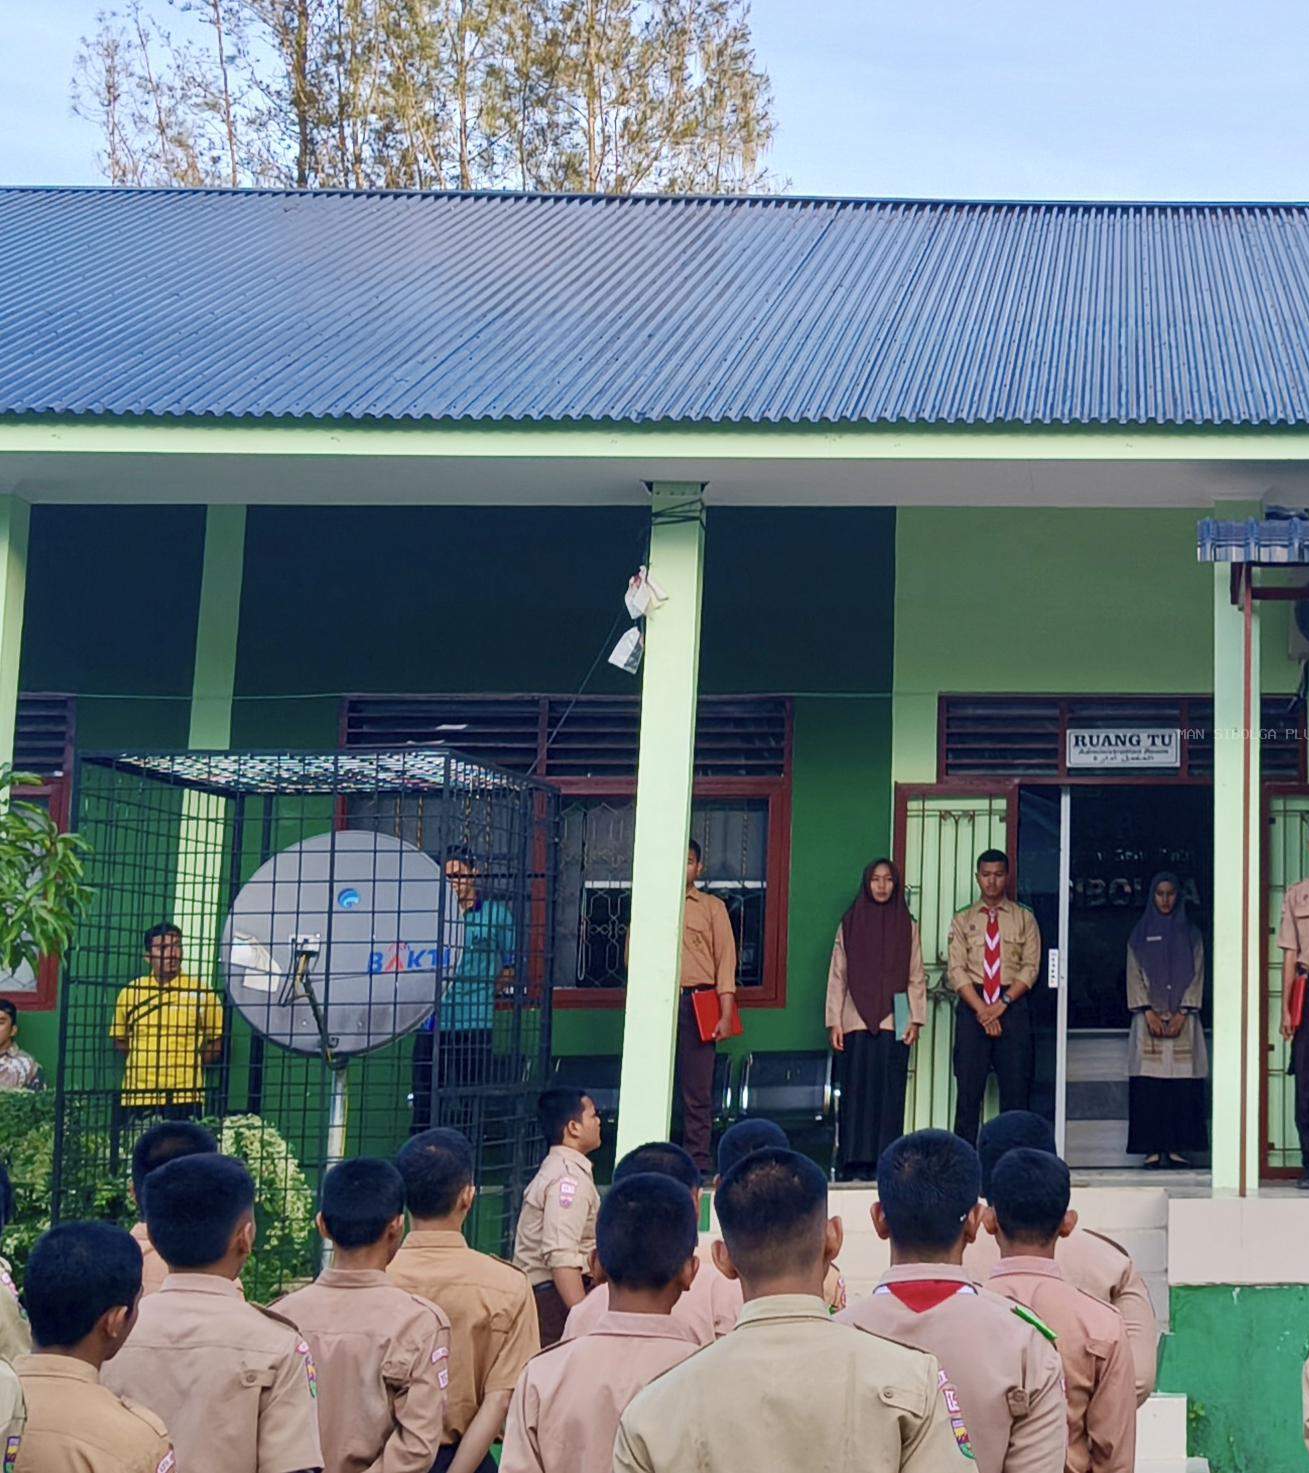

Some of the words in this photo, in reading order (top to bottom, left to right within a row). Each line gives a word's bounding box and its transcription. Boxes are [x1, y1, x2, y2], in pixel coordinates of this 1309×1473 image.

[1073, 734, 1141, 747] RUANG
[1147, 734, 1173, 747] TU
[1068, 878, 1200, 905] IBOLA
[368, 946, 451, 975] BAKTI
